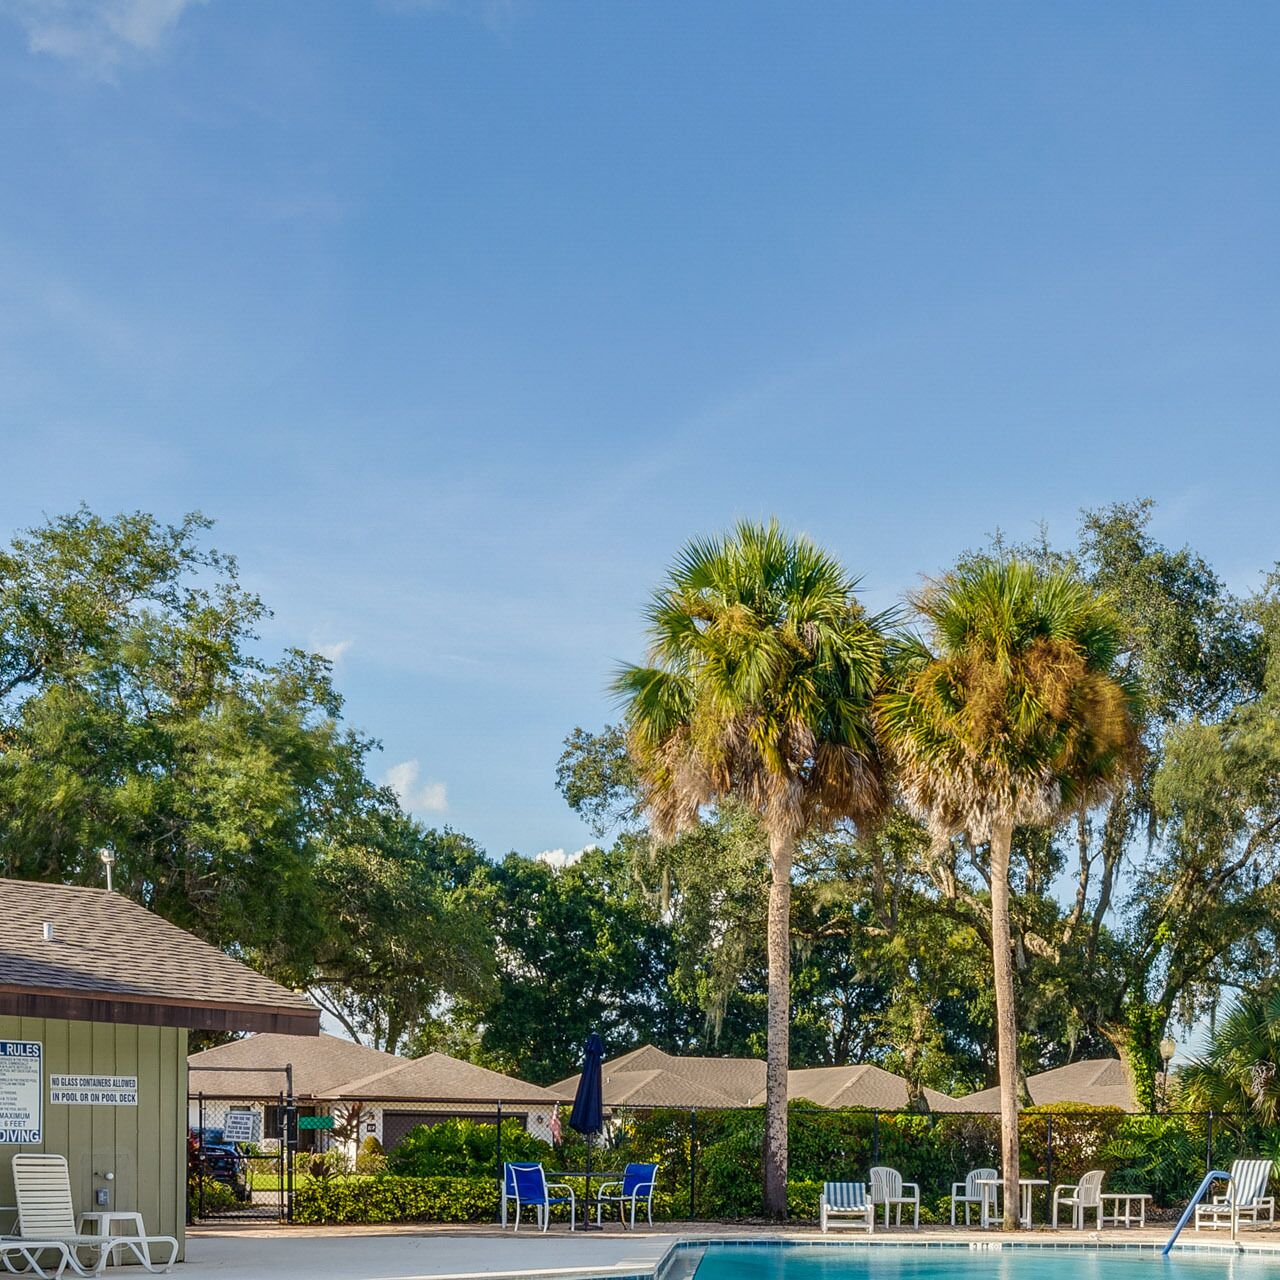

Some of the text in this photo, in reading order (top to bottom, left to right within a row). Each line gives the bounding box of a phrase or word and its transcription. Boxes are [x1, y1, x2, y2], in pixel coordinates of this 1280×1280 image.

[6, 1044, 39, 1057] RULES
[52, 1077, 136, 1088] NO GLASS CONTAINERS ALLOWED
[52, 1092, 136, 1103] IN POOL OR ON POOL DECK
[0, 1112, 30, 1120] MAXIMUM
